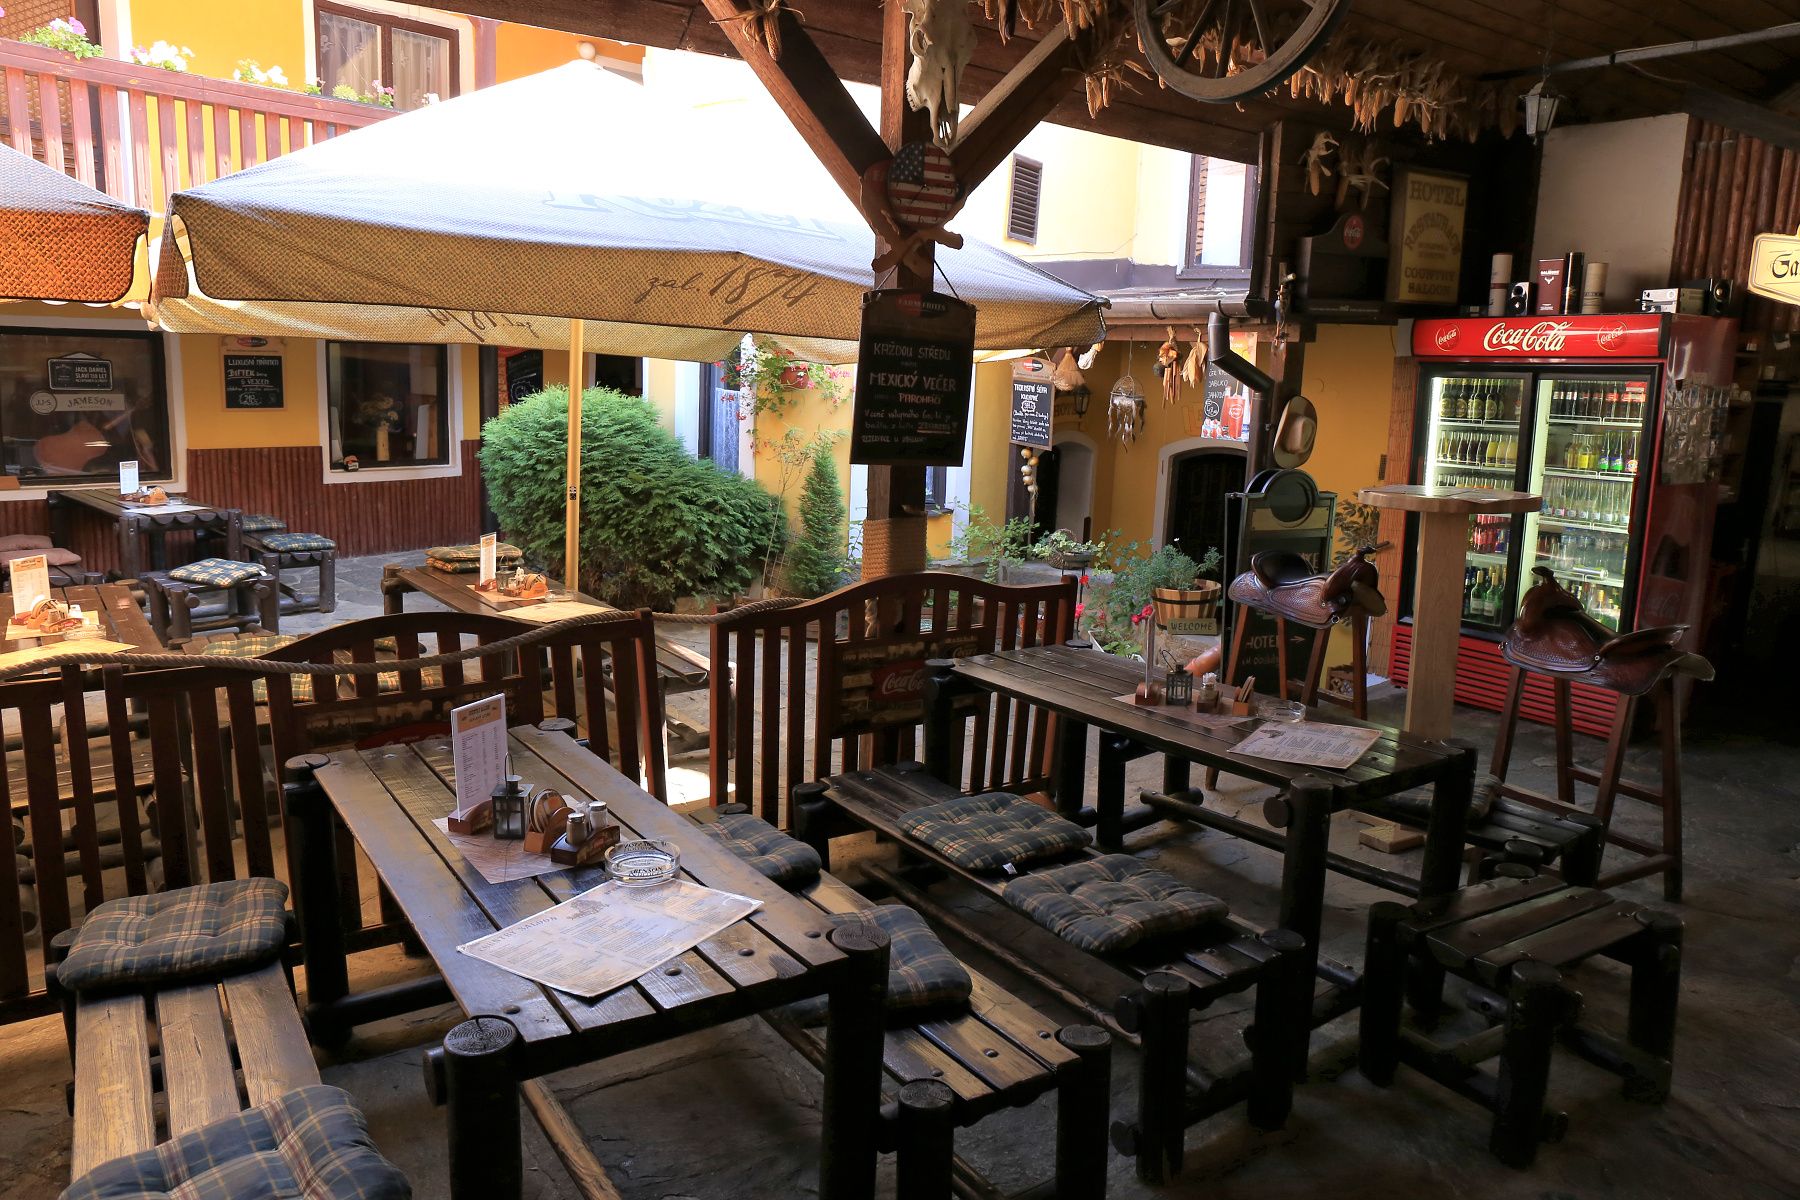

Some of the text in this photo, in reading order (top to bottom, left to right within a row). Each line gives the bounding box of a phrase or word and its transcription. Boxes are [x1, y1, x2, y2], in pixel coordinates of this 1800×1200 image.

[1409, 180, 1465, 207] HOTEL
[1404, 266, 1456, 282] COUNTRY
[635, 264, 820, 325] zal. 1874
[1408, 282, 1453, 296] SALOON
[1483, 321, 1574, 351] Coca-Cola
[869, 370, 956, 392] MEXICKÝ VEČER
[67, 397, 113, 408] JAMESON
[1170, 622, 1214, 631] WELCOME
